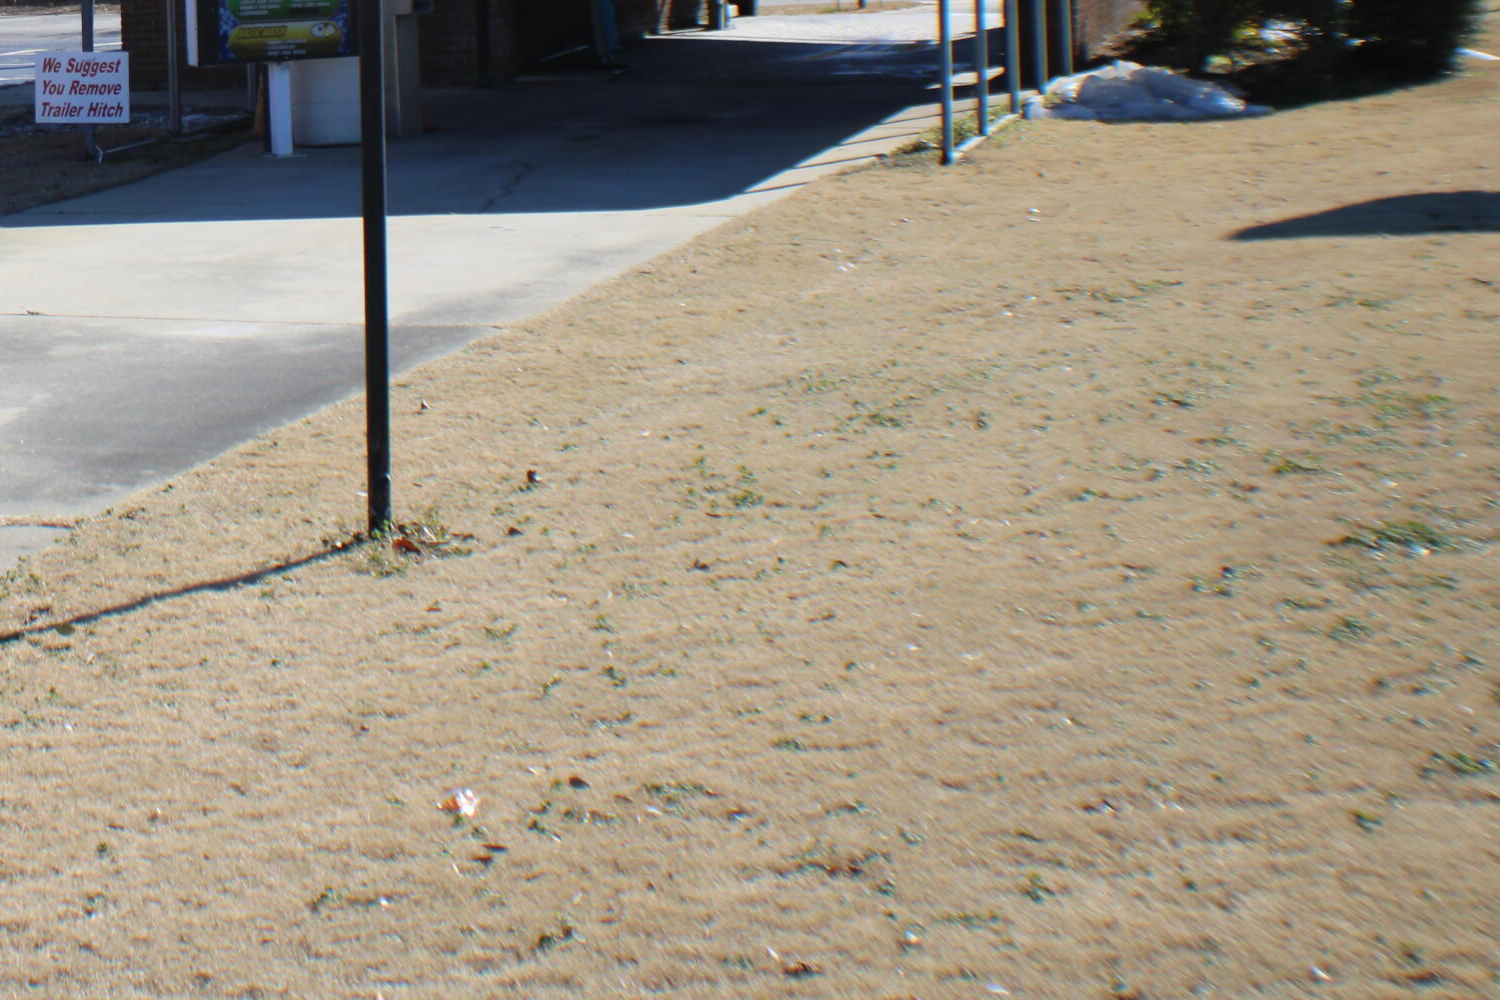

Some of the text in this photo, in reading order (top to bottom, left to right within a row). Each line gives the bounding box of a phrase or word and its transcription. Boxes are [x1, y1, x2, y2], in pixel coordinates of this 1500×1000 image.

[42, 58, 121, 77] We Suggest
[42, 80, 122, 95] You Remove
[41, 102, 124, 117] Trailer Hitch
